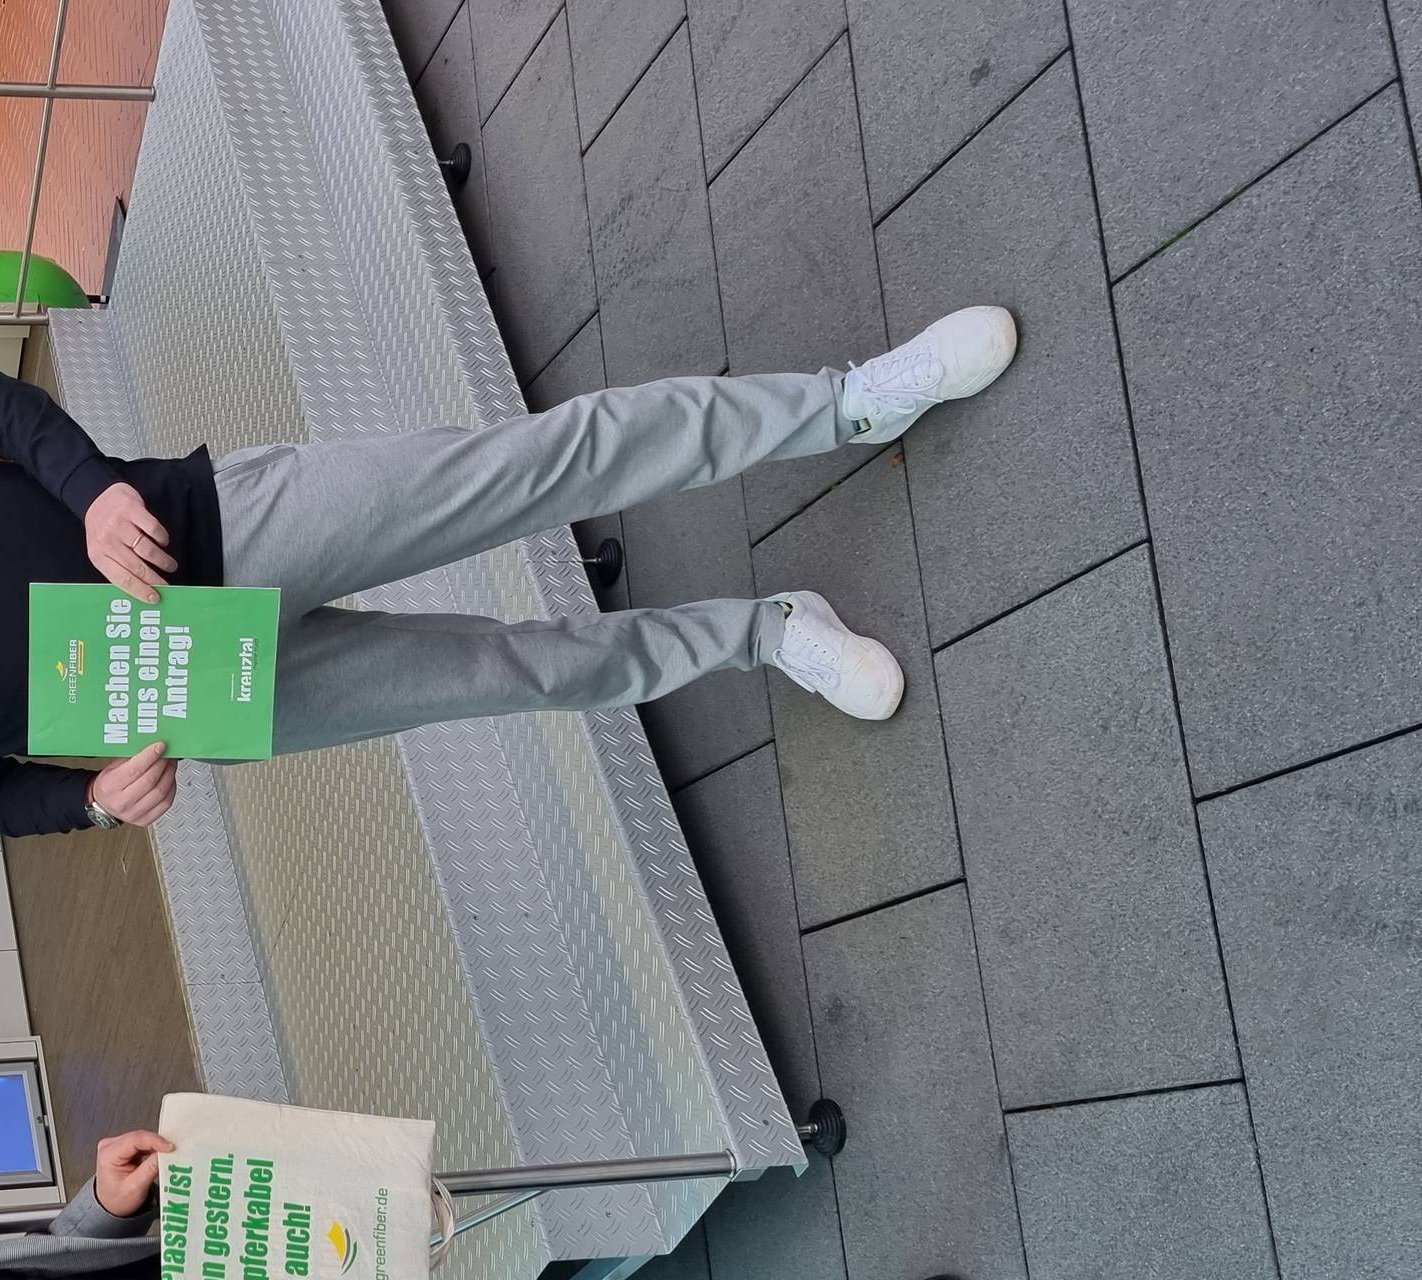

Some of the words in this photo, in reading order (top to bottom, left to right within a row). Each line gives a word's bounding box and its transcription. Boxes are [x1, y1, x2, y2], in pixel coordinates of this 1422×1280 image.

[105, 598, 132, 639] Sie
[134, 610, 161, 681] einen
[68, 639, 78, 704] GREENFIBER
[104, 645, 130, 744] Machen
[162, 625, 193, 719] Antrag!
[236, 637, 254, 702] kreuztal
[137, 687, 159, 734] uns
[164, 1164, 193, 1197] ist
[203, 1154, 234, 1257] gestern.
[282, 1202, 311, 1276] auch!
[372, 1187, 389, 1280] greenfiber.de
